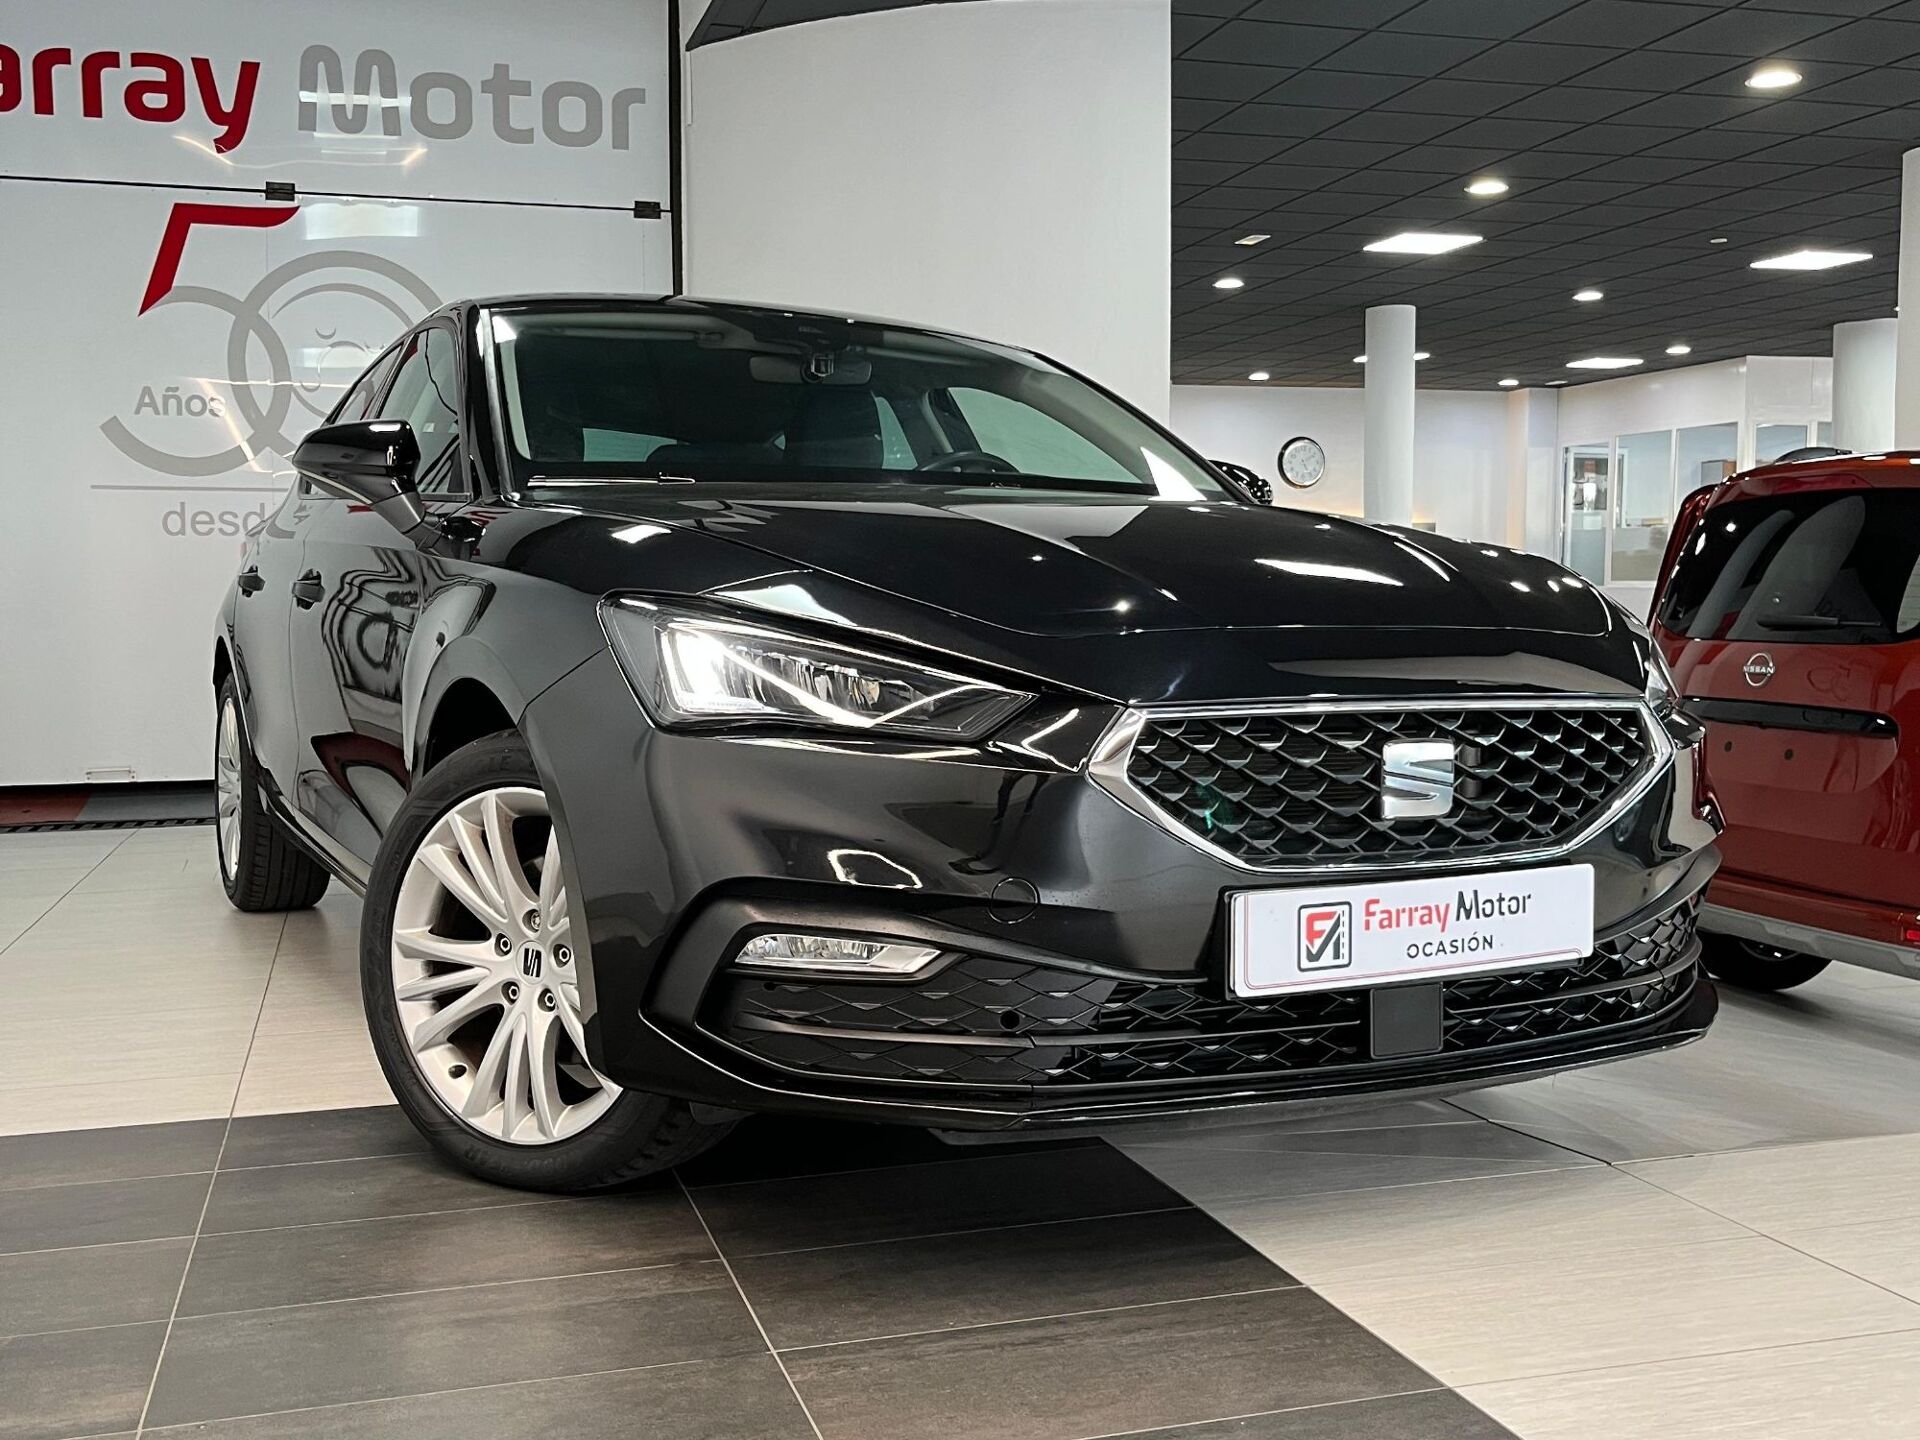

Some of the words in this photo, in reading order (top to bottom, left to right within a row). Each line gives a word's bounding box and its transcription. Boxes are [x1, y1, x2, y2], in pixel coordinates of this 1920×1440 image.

[299, 44, 646, 150] Motor
[134, 386, 225, 417] Años
[1743, 665, 1776, 674] NISSAN
[1364, 898, 1450, 933] Farray
[1455, 889, 1532, 923] Motor
[1406, 931, 1494, 959] OCASIÓN
